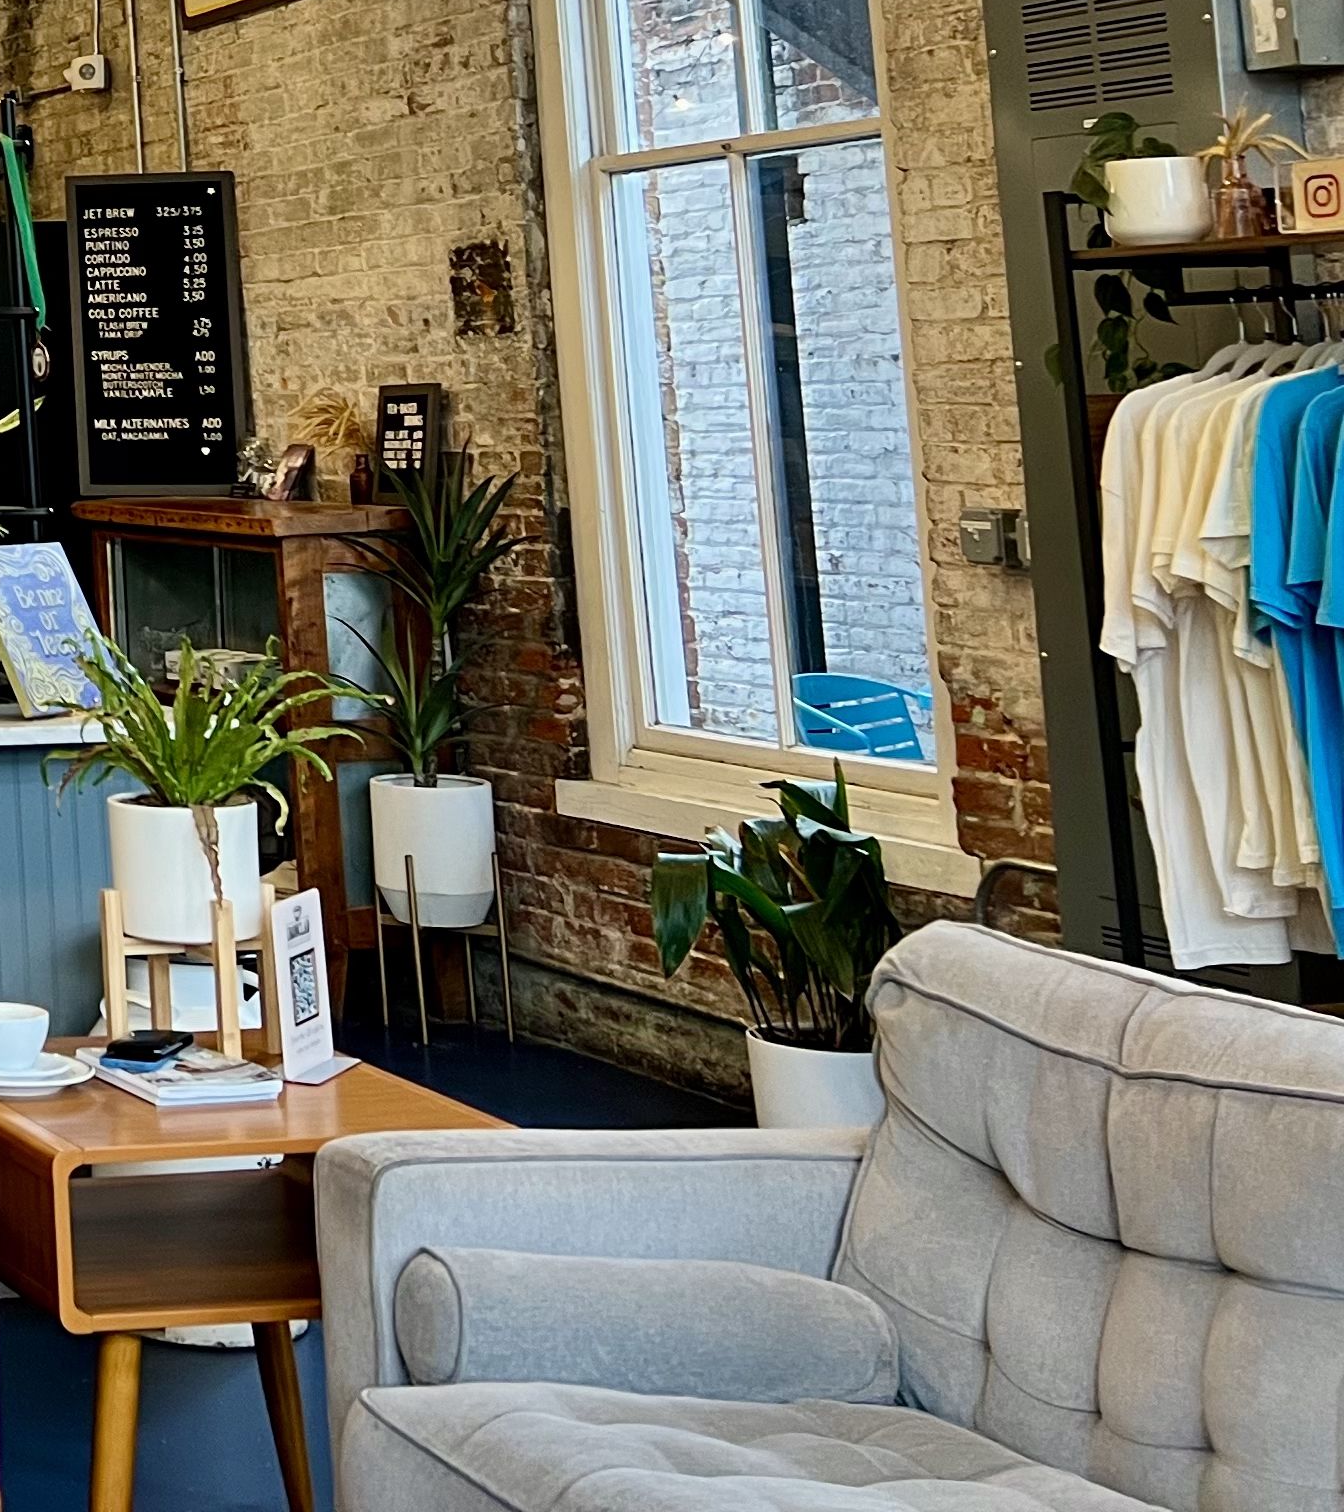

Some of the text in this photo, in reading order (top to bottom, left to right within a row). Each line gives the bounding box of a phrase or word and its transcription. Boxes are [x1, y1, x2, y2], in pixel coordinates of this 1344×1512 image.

[83, 209, 102, 219] JET
[106, 208, 135, 218] BREW
[84, 227, 139, 238] ESPRESSO
[85, 241, 130, 251] PUNTINO
[84, 253, 208, 264] CORTADO 4.00
[86, 264, 208, 277] CAPPUCCINO 4.50
[87, 280, 121, 290] LATTE
[87, 293, 148, 303] AMERICANO
[88, 308, 160, 319] COLD COFFEE
[91, 350, 216, 361] SYRUPS ADD
[94, 418, 222, 429] MILK ALTERNATIVES ADD
[13, 585, 65, 608] Be nice
[39, 611, 58, 631] or
